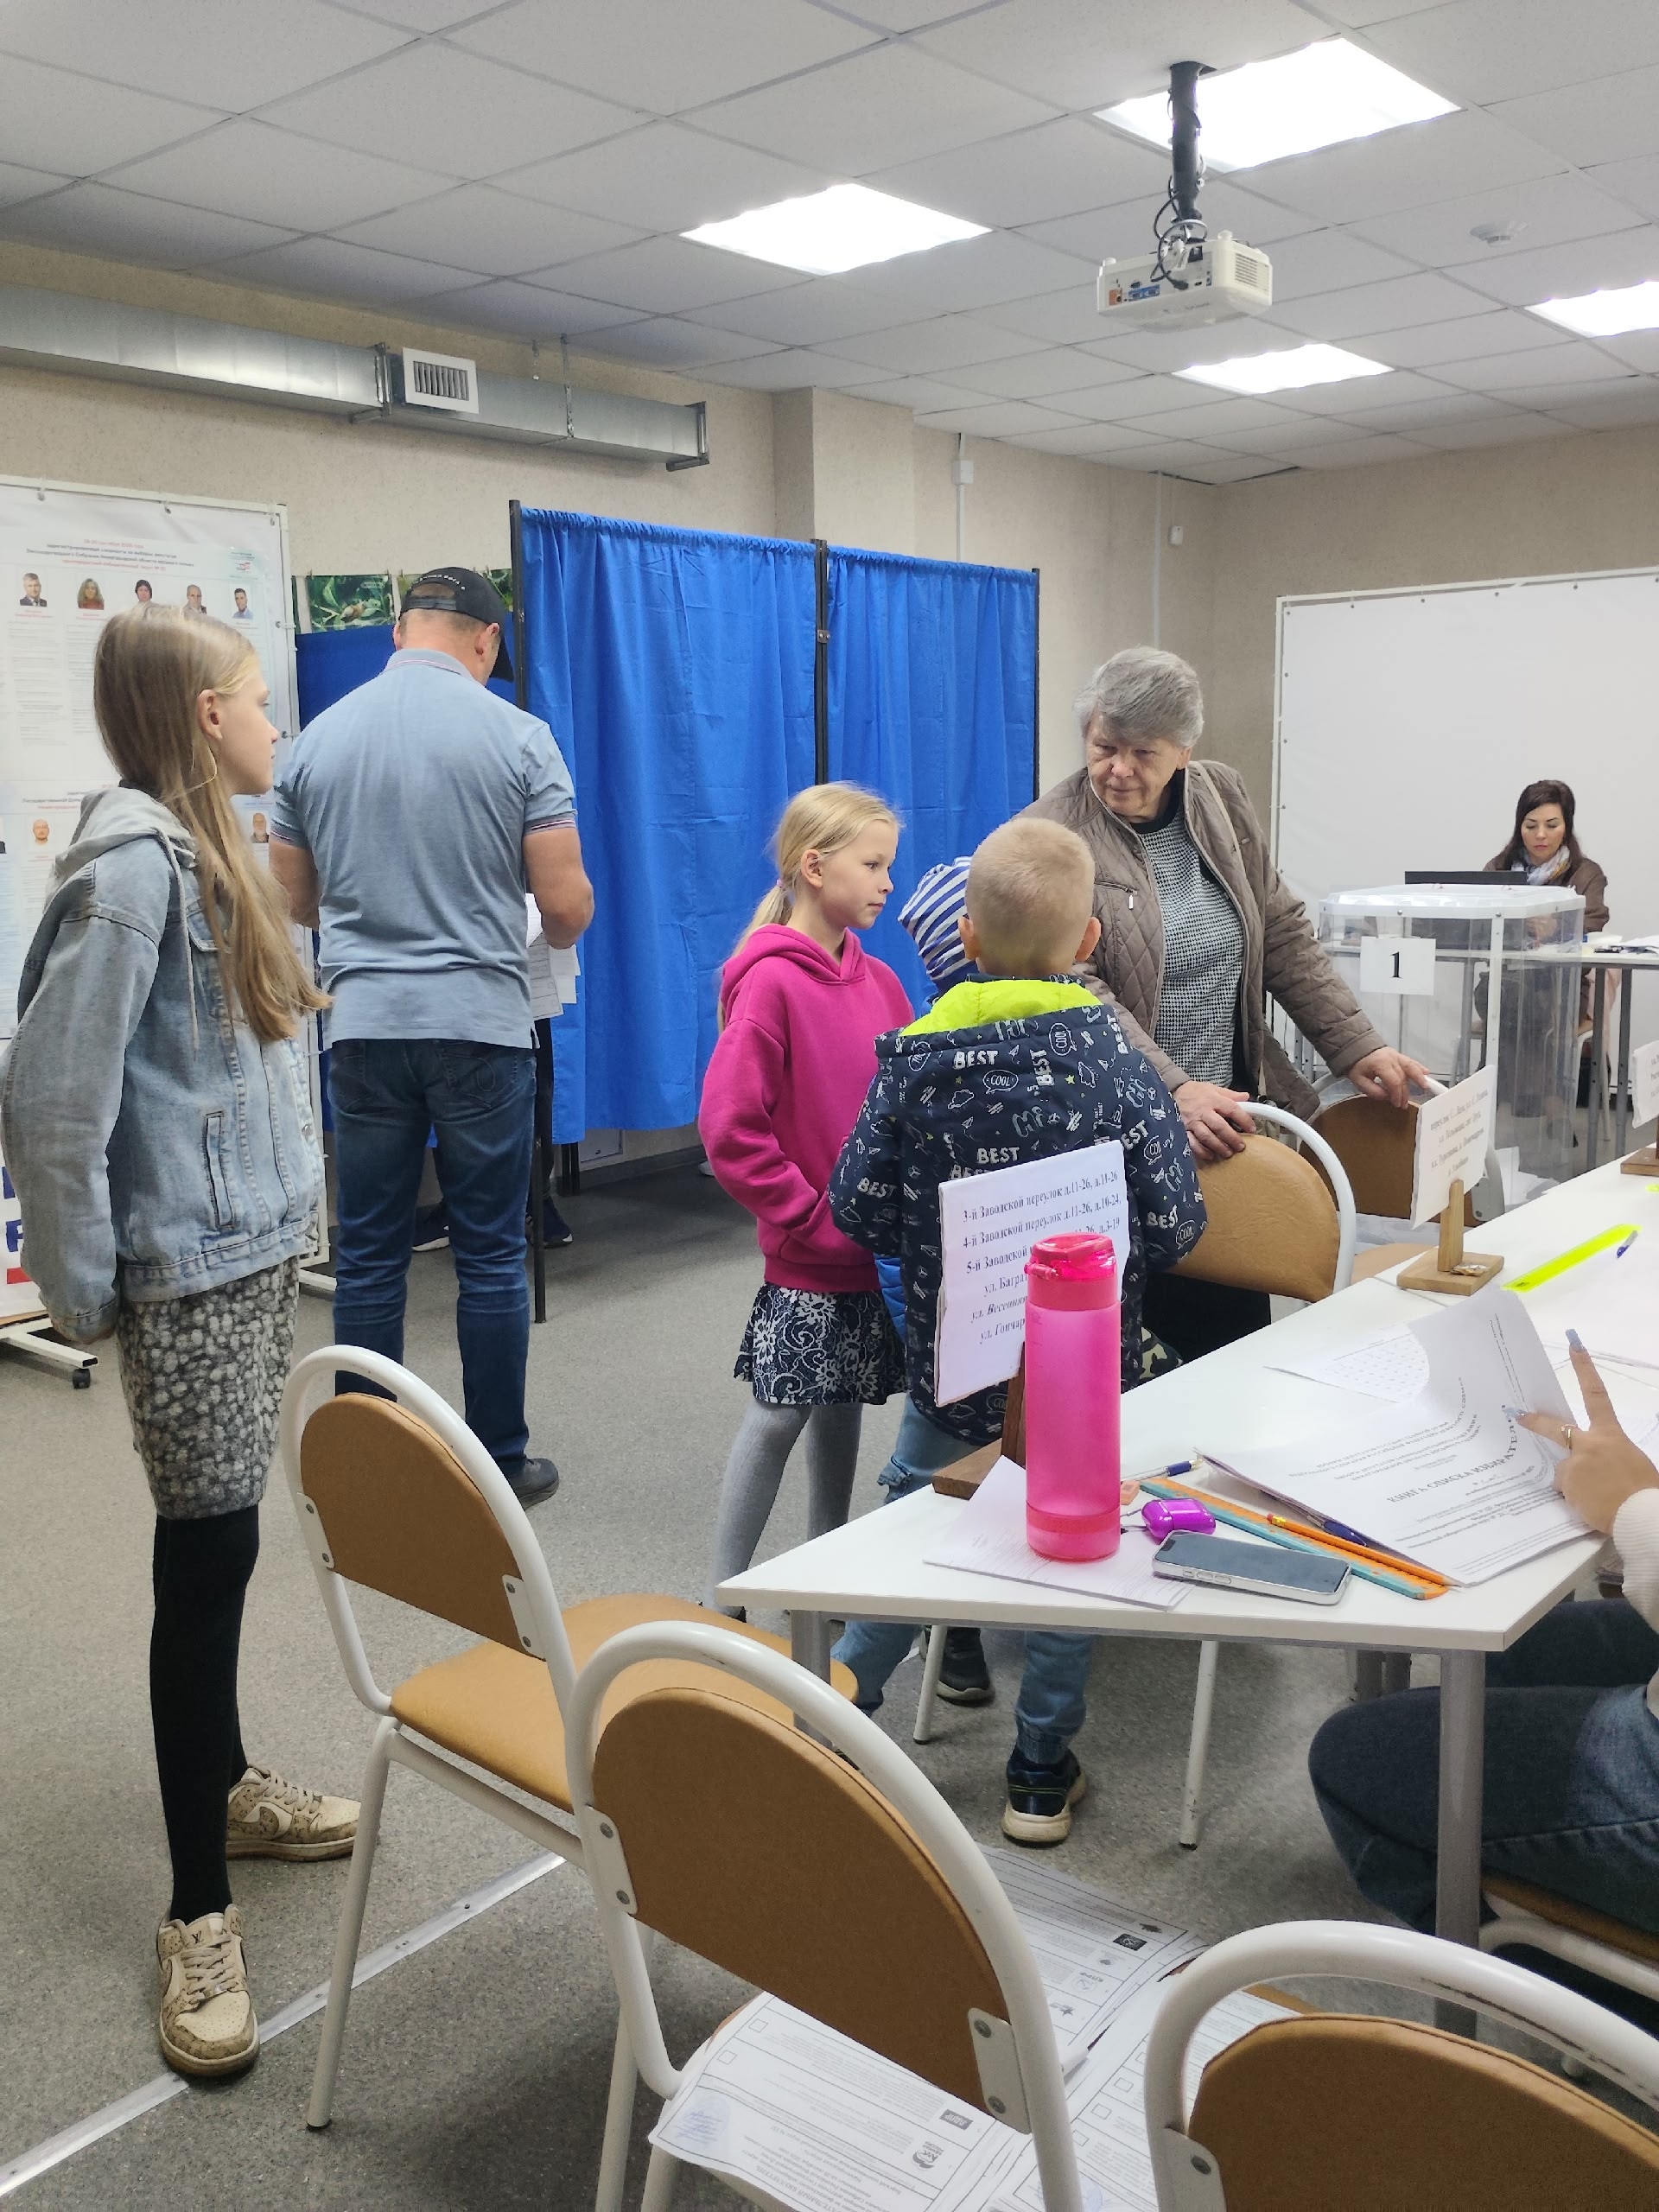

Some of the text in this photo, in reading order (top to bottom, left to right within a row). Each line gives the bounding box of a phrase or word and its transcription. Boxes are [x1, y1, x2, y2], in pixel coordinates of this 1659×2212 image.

[1389, 950, 1403, 979] 1
[953, 1050, 999, 1070] BEST
[1030, 1049, 1055, 1086] BEST
[990, 1075, 1011, 1086] COOL
[1122, 1120, 1149, 1151] EST
[977, 1147, 1020, 1164] BEST
[857, 1177, 898, 1198] BEST
[963, 1209, 977, 1222] 3-й
[980, 1196, 1024, 1218] Заводской
[1027, 1188, 1063, 1206] переулок
[1146, 1205, 1179, 1230] BEST
[963, 1234, 977, 1249] 4-й
[980, 1221, 1024, 1244] Заводской
[1026, 1212, 1062, 1231] переулок
[967, 1259, 981, 1274] 5-й
[983, 1246, 1027, 1269] Заводской
[984, 1284, 997, 1297] ул.
[970, 1310, 983, 1324] ул.
[980, 1330, 993, 1344] ул.
[1387, 1486, 1428, 1503] КНИГА
[1427, 1471, 1473, 1490] СПИСКА
[1470, 1405, 1517, 1473] ИЗБИРАТЕЛ
